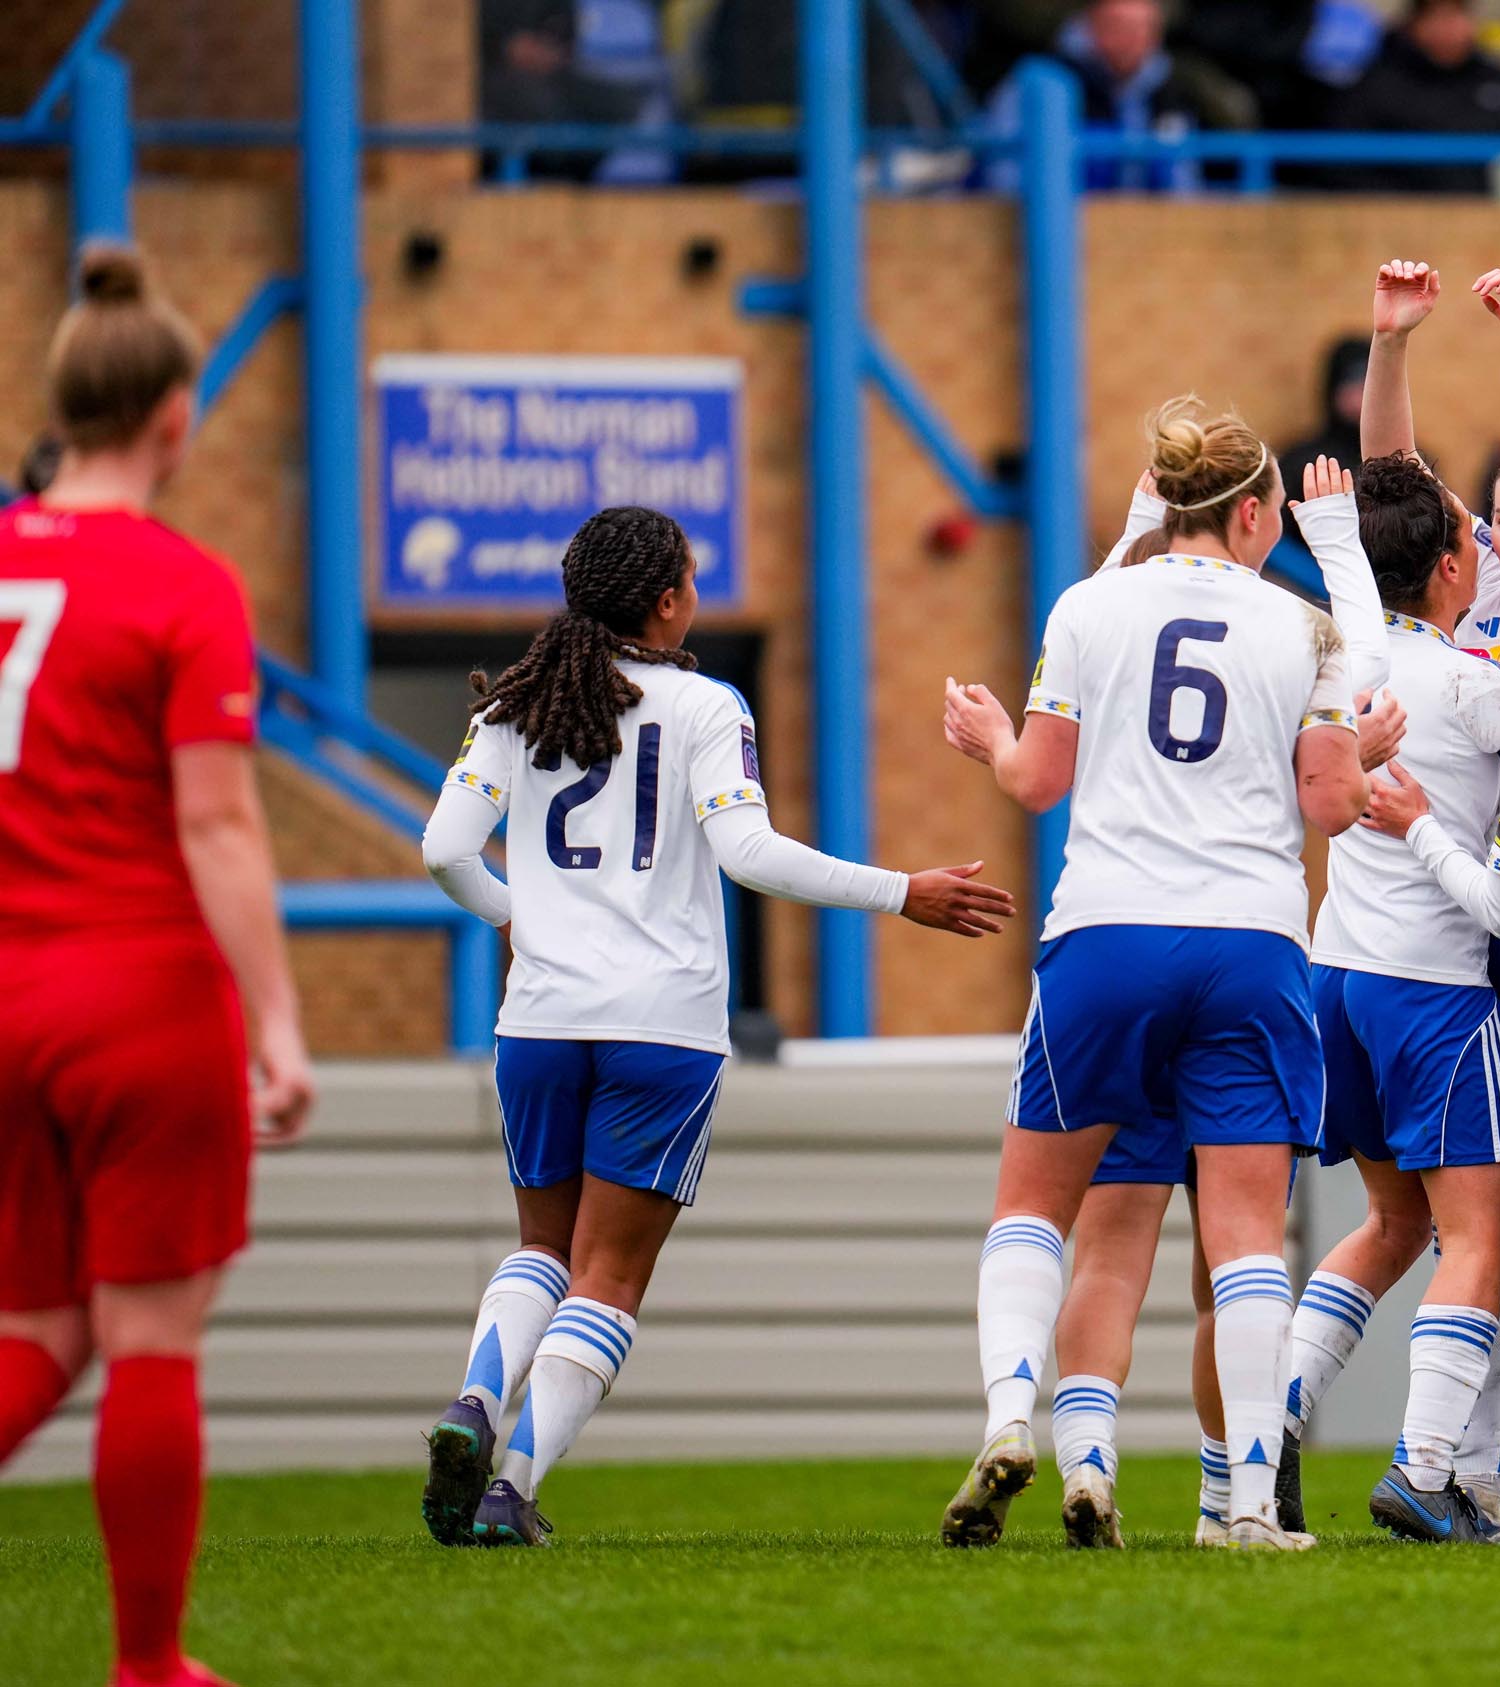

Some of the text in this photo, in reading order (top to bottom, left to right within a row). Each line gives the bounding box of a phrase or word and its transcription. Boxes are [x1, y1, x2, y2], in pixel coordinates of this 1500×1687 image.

[421, 385, 698, 447] The Norman
[597, 446, 727, 513] Stand
[1148, 618, 1228, 763] 6
[544, 722, 661, 872] 21
